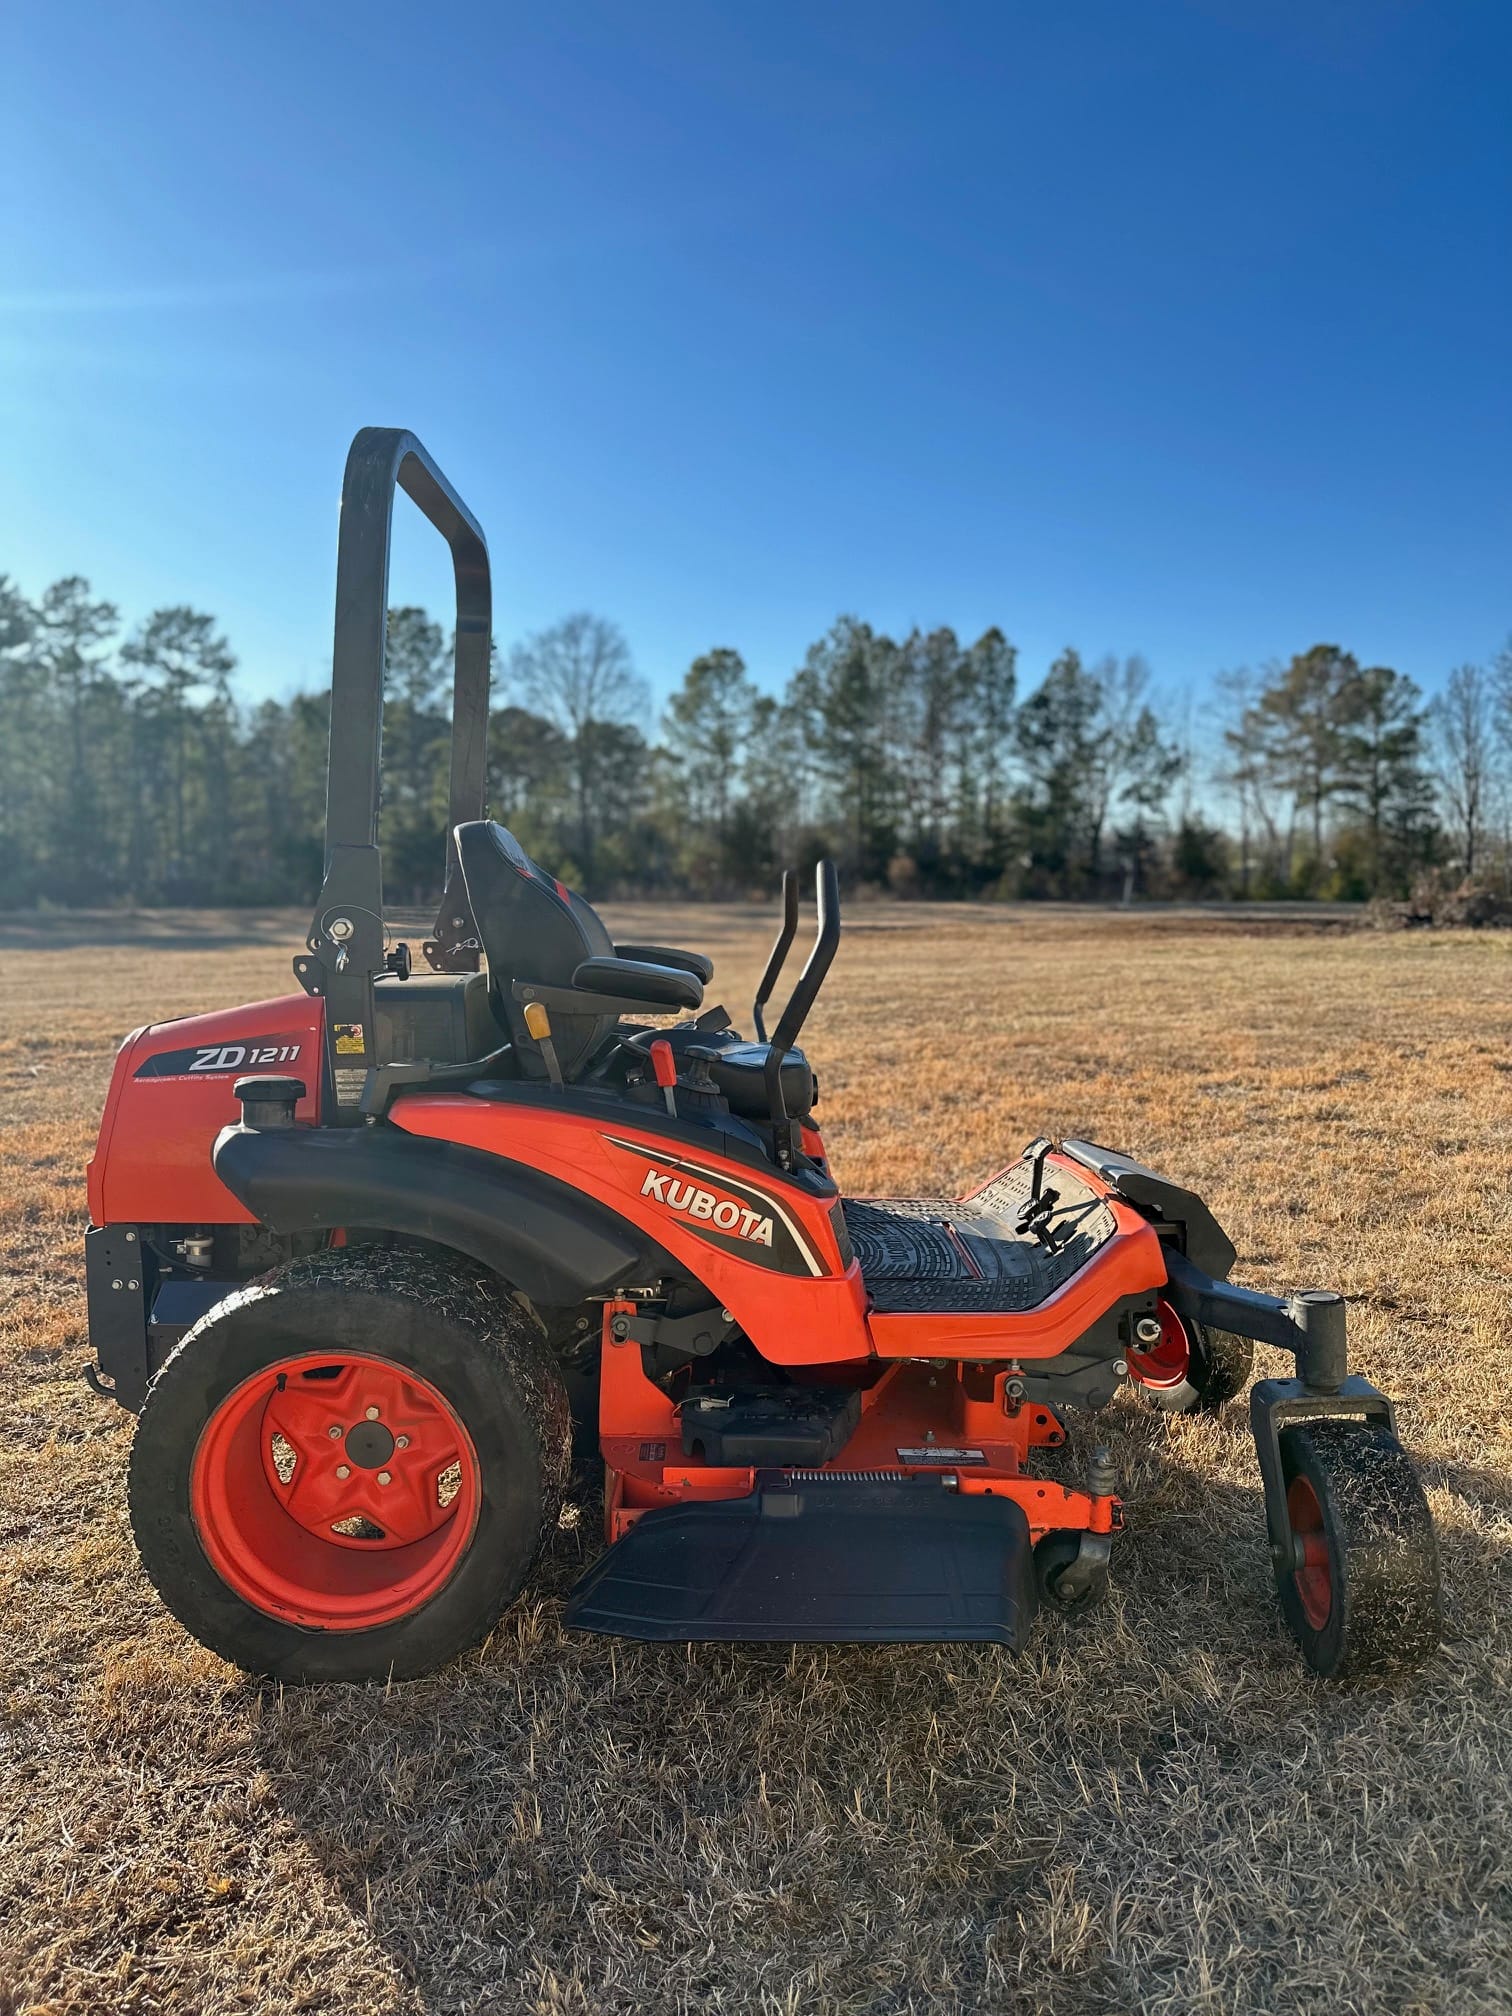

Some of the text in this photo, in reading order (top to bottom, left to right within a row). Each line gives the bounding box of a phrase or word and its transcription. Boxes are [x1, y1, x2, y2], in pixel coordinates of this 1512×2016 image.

[189, 1045, 301, 1071] ZD 1211
[640, 1169, 774, 1248] KUBOTA
